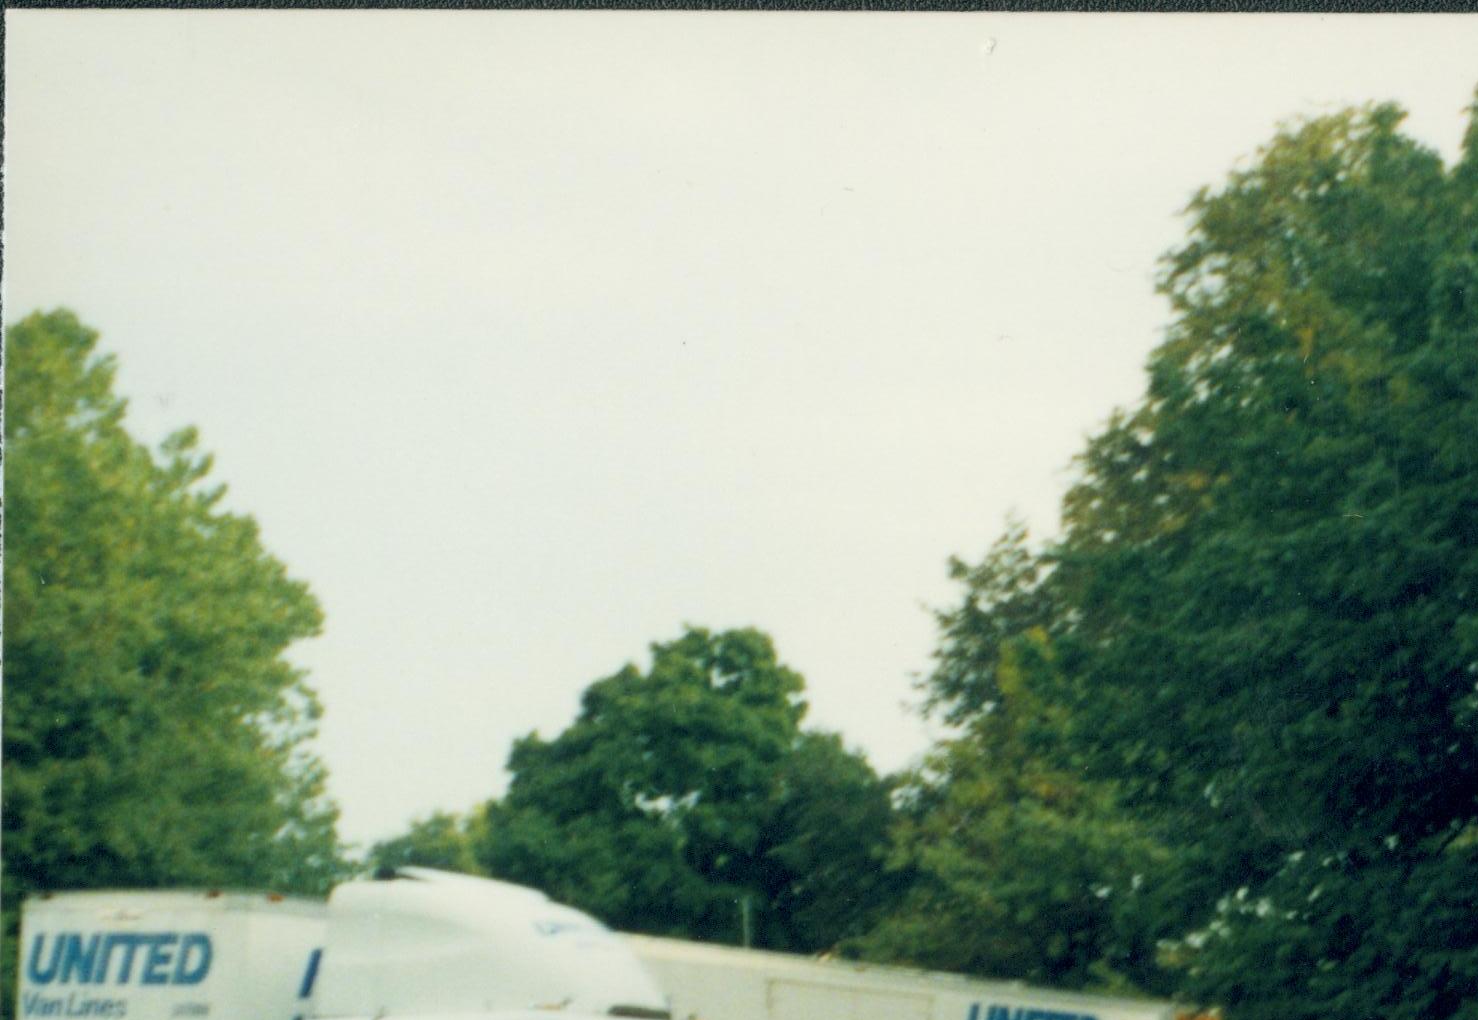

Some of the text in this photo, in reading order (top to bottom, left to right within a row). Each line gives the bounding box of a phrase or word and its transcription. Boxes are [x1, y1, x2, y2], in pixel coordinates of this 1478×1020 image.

[27, 932, 213, 986] UNITED
[23, 992, 127, 1018] Van Lines
